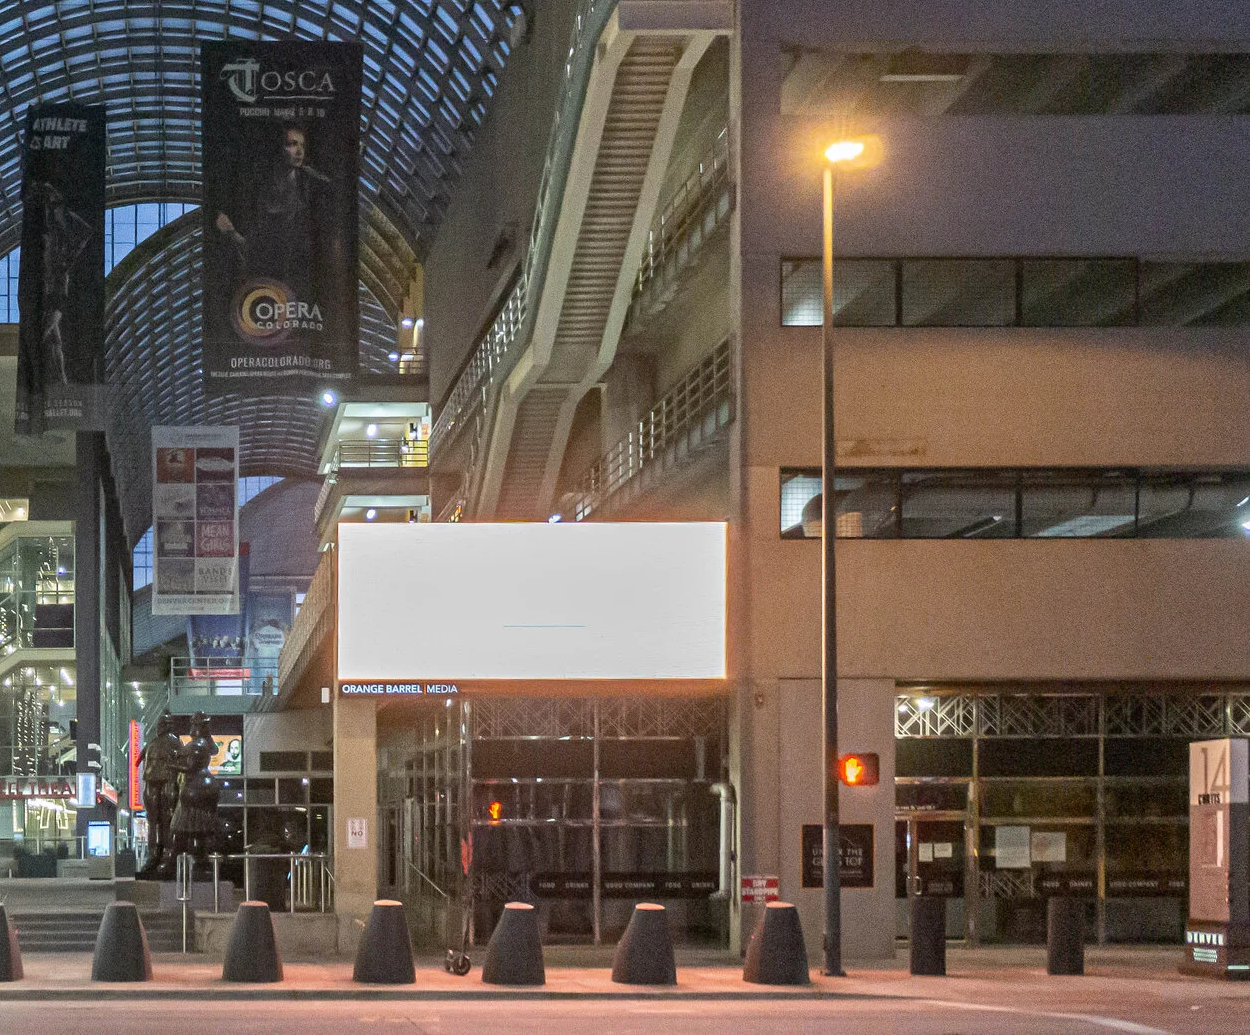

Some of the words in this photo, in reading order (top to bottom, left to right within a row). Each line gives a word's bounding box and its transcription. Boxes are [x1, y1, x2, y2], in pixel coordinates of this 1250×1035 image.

[220, 58, 335, 103] TOSCA
[33, 117, 88, 133] ATHLETE
[255, 302, 323, 321] OPERA
[256, 321, 323, 331] COLORADO
[342, 684, 384, 694] ORANGE
[386, 684, 423, 694] BARREL
[426, 684, 458, 694] MEDIA
[1200, 747, 1230, 804] 14
[1186, 931, 1224, 946] DENVER
